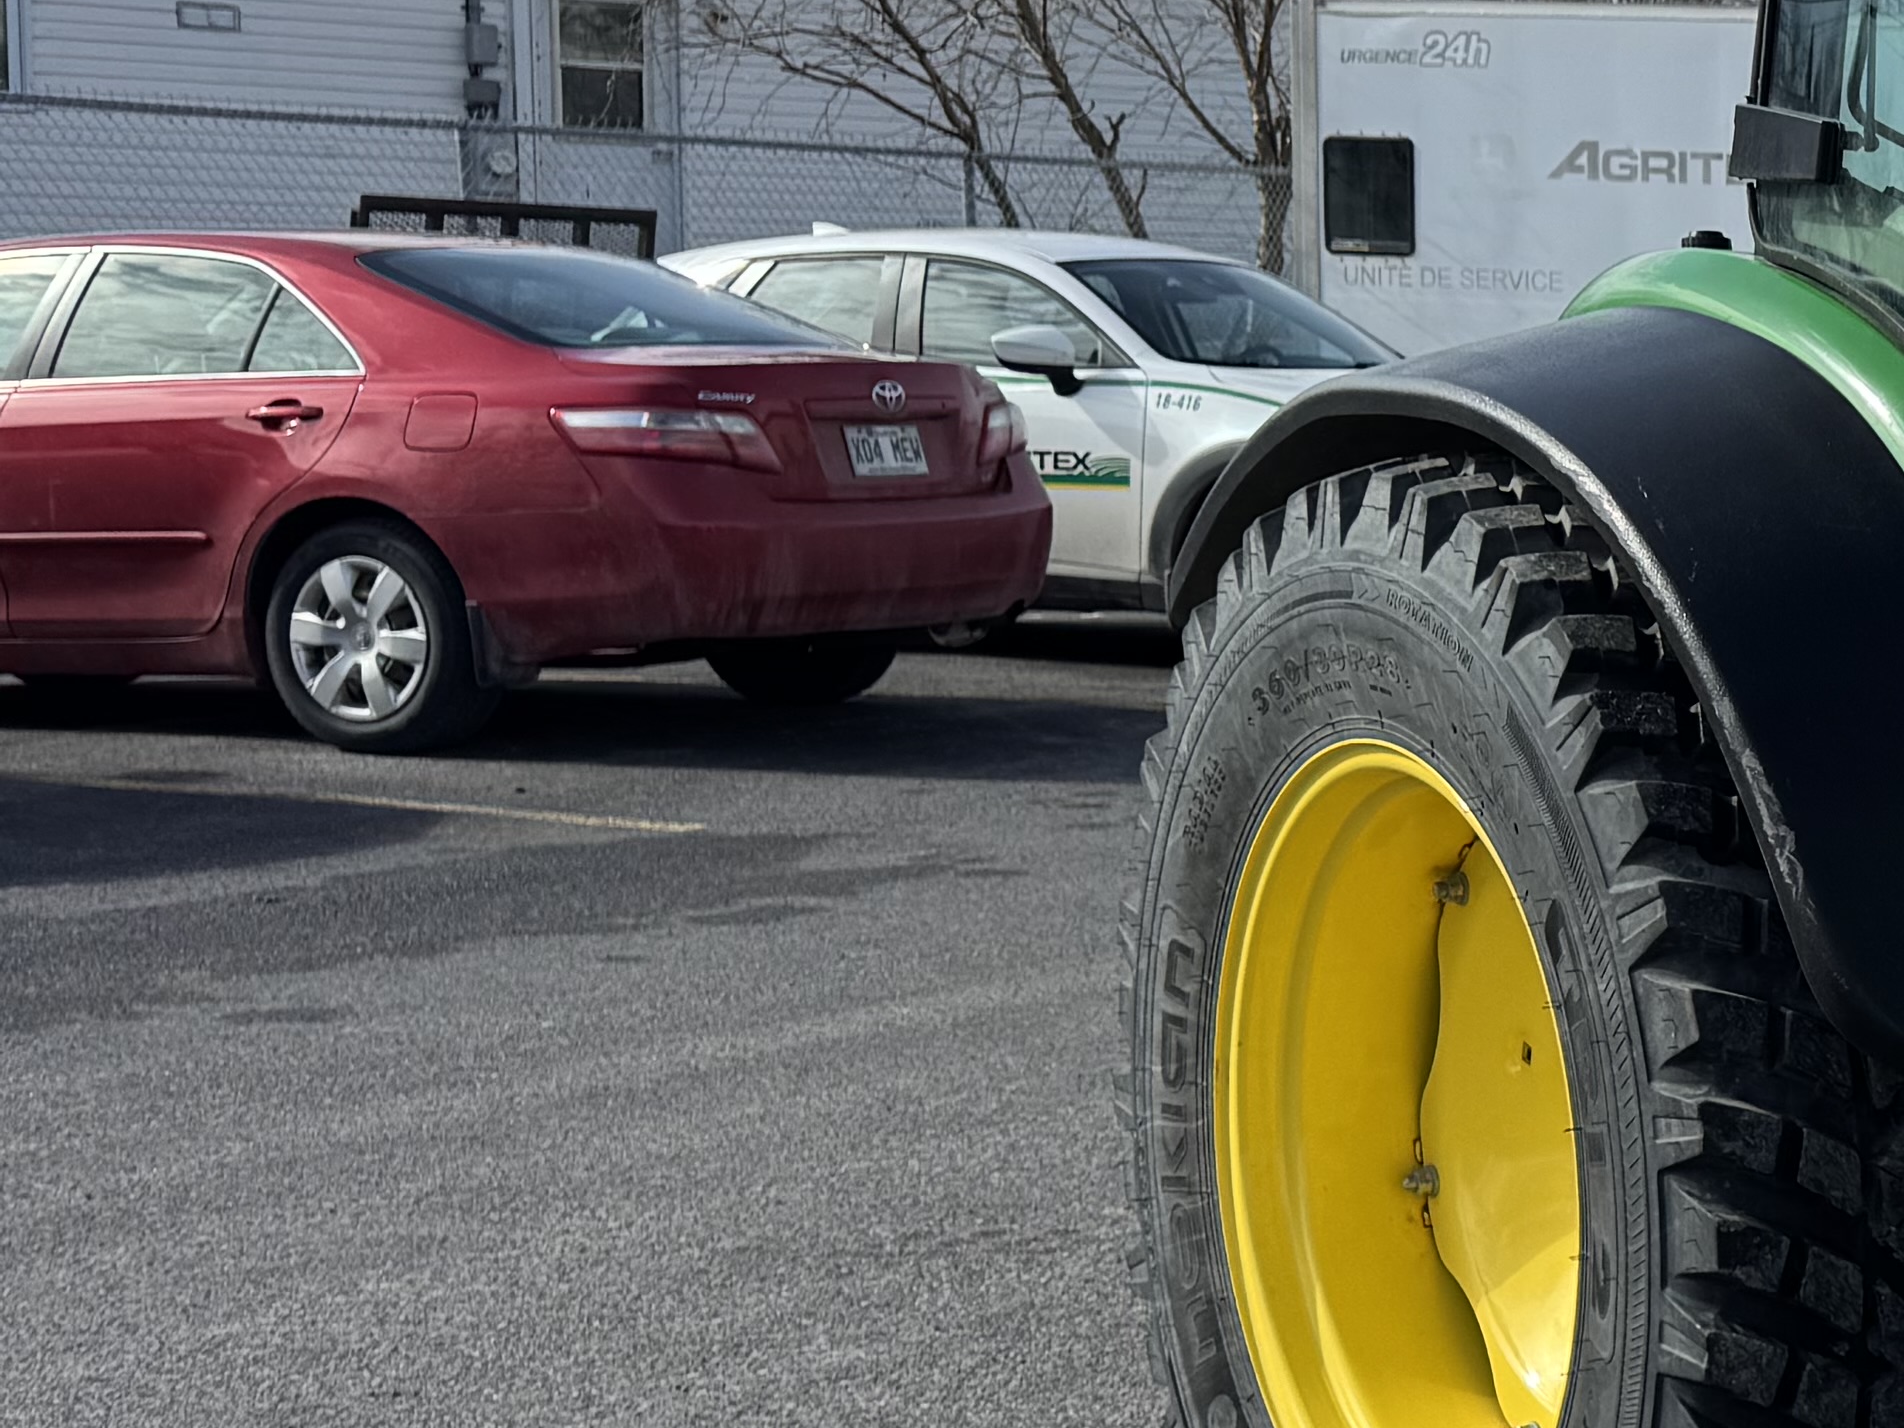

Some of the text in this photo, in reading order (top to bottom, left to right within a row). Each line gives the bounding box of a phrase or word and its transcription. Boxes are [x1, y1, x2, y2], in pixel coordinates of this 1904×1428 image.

[1340, 30, 1491, 69] URGENCE 24h
[1420, 266, 1453, 289] DE
[1459, 267, 1564, 292] SERVICE
[851, 436, 884, 465] X04
[1386, 587, 1475, 672] ROTATION
